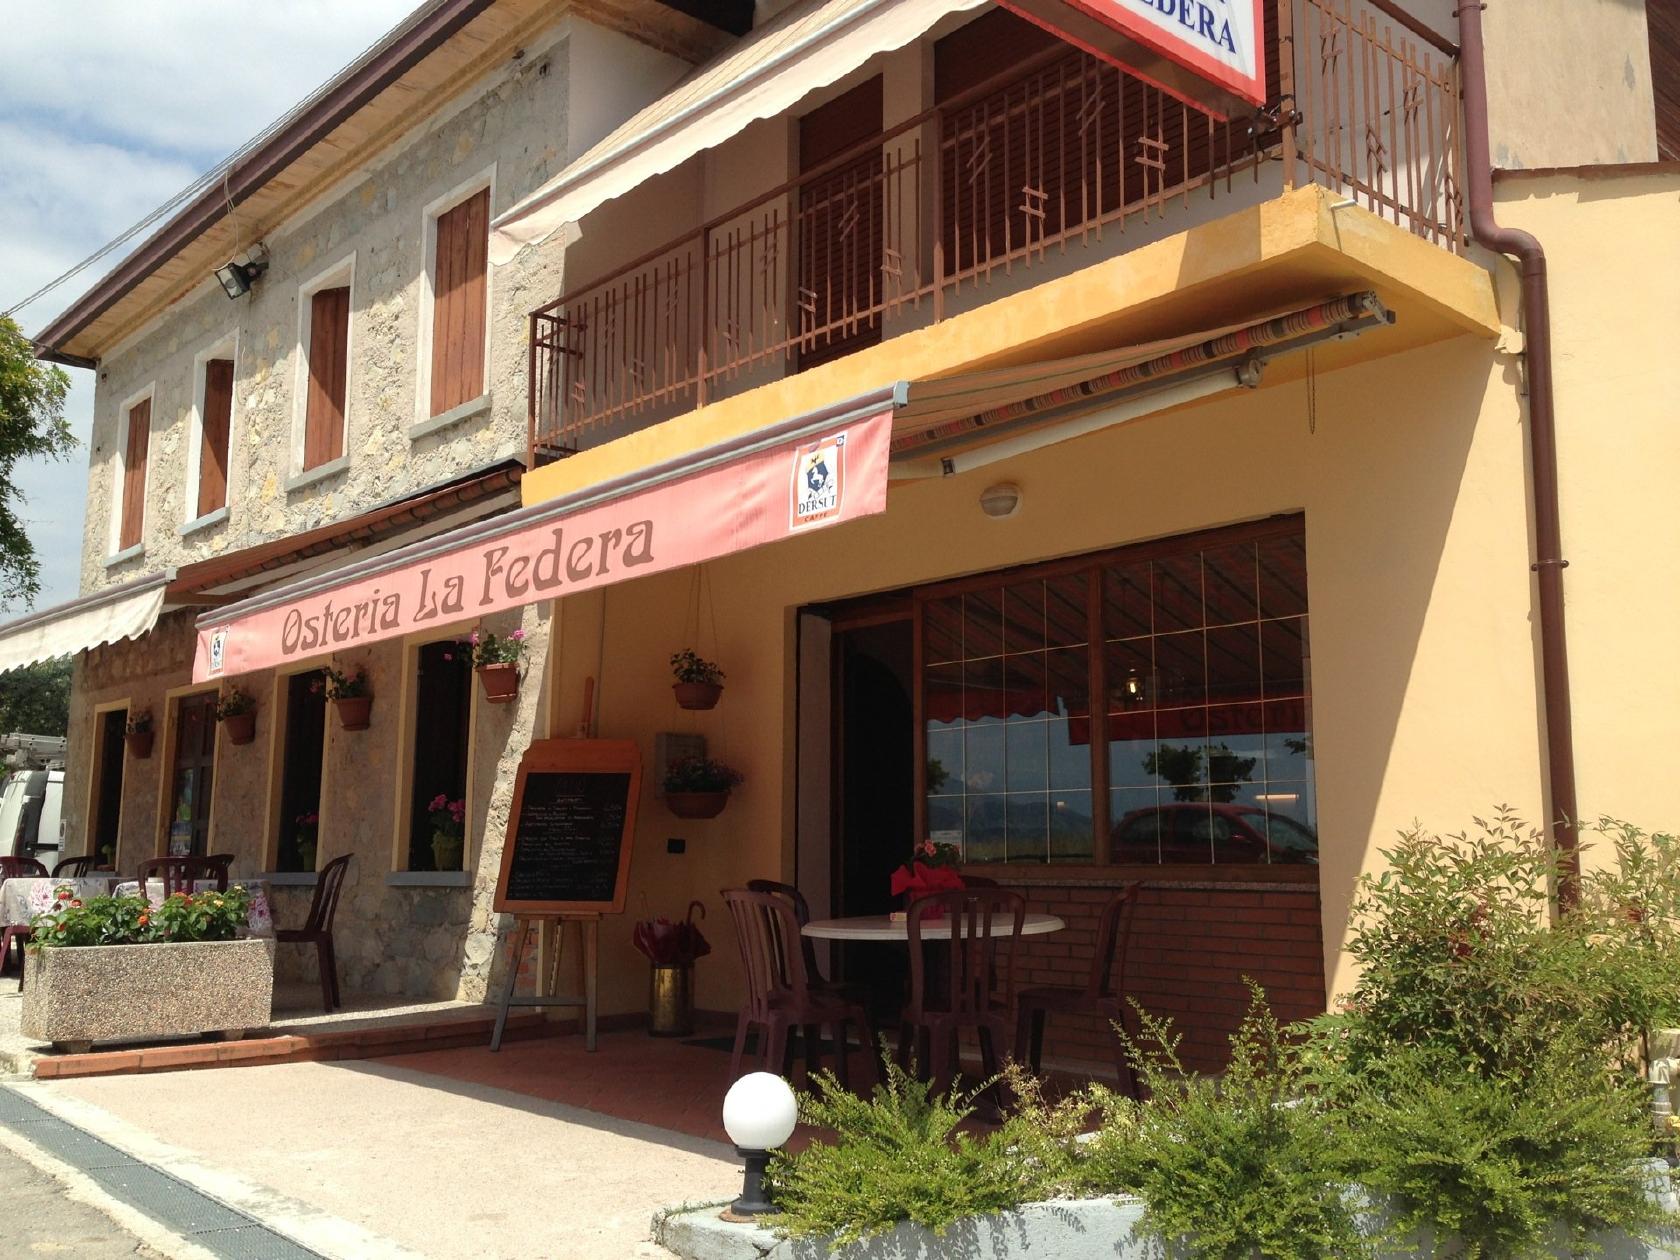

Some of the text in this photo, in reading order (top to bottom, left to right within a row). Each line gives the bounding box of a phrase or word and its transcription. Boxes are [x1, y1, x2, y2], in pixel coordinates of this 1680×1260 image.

[1141, 0, 1236, 54] DERA
[281, 519, 655, 655] Osteria La Federa
